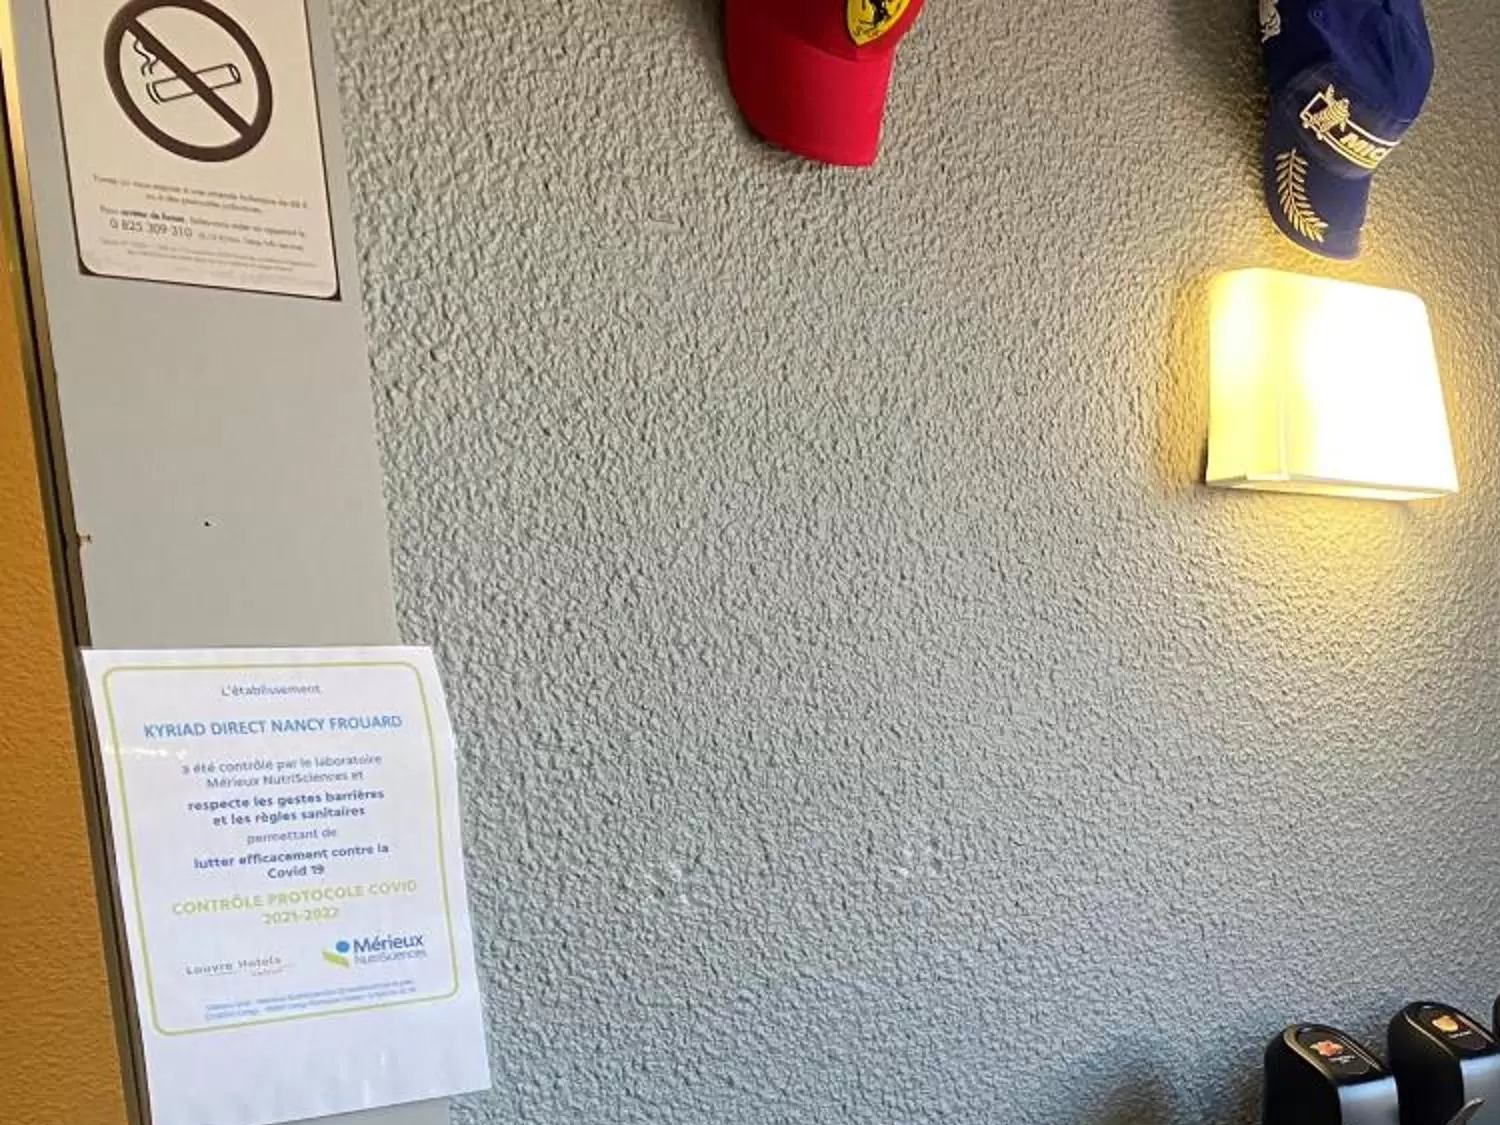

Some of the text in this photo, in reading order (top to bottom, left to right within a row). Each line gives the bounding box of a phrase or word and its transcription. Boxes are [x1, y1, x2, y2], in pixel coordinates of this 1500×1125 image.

[143, 714, 403, 738] KYRIAD DIRECT NANCY FROUARD
[192, 760, 215, 773] été
[219, 757, 273, 772] contrôlé
[277, 760, 297, 774] par
[300, 756, 312, 768] le
[314, 752, 382, 768] laboratoire
[206, 770, 363, 788] Mérieux NutriSciences et
[187, 788, 385, 813] respecte les gestes barrières
[212, 805, 365, 827] et les règles sanitaires
[247, 826, 336, 845] permettant de
[194, 843, 389, 869] lutter efficacement contre la
[267, 863, 325, 879] Covid 19
[172, 879, 417, 915] CONTRÔLE PROTOCOLE COVID
[353, 934, 424, 953] Mérieux
